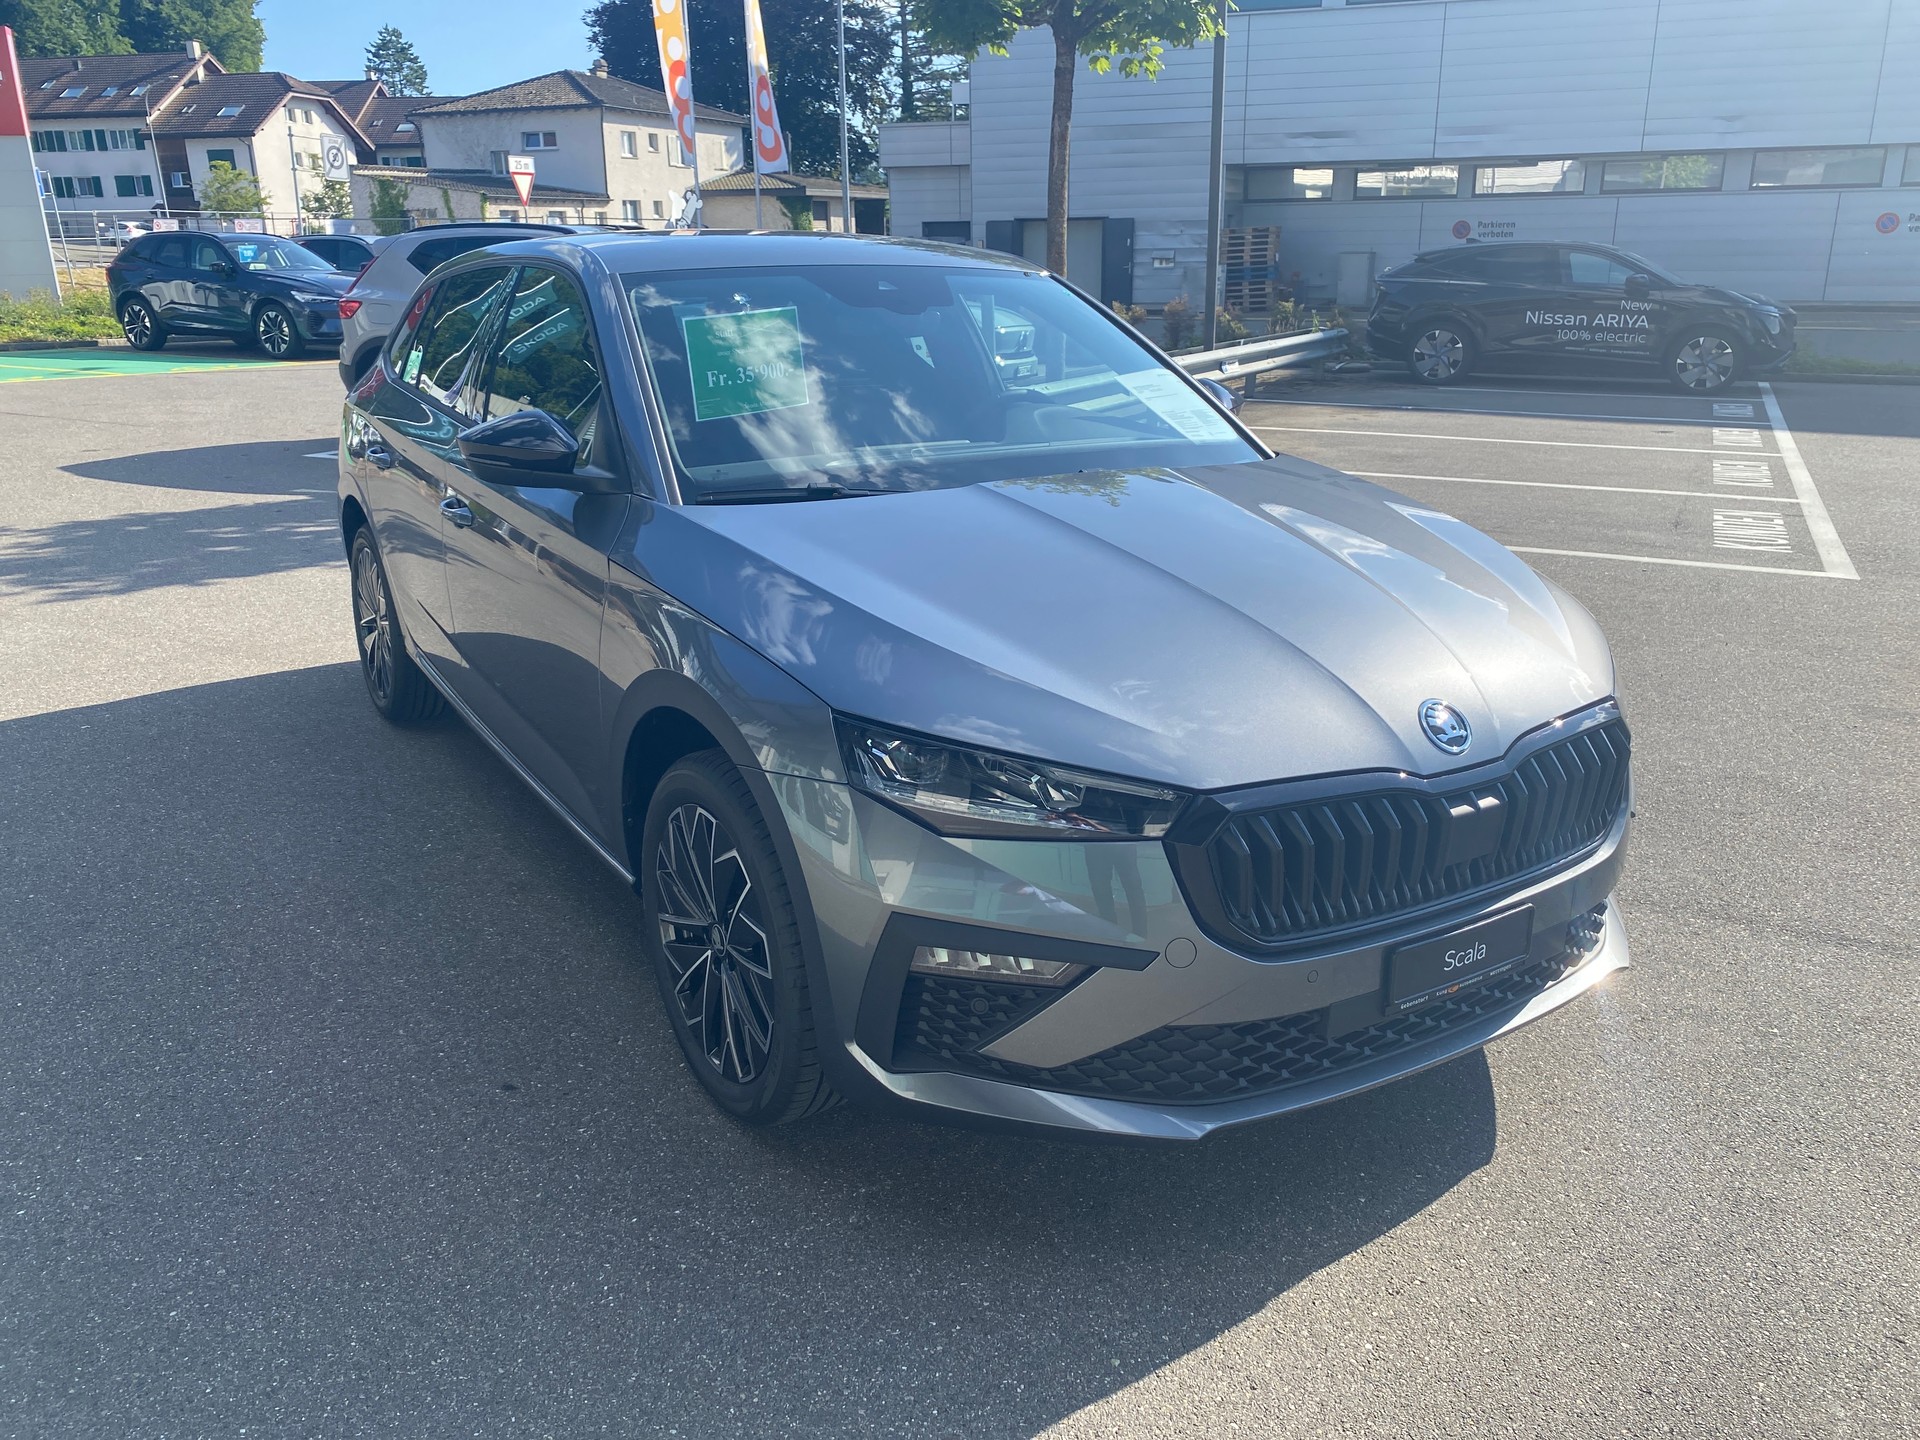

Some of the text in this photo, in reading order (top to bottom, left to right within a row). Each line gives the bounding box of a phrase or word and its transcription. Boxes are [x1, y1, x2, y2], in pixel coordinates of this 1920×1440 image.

[515, 160, 523, 170] 25
[1477, 220, 1516, 229] Parkieren
[1477, 230, 1514, 238] verboten
[1620, 299, 1653, 311] New
[1525, 310, 1649, 329] Nissan ARIYA
[1557, 329, 1647, 343] 100% electric
[706, 370, 732, 388] Fr.
[1712, 508, 1794, 554] KUNDEN
[1443, 941, 1487, 971] Scala
